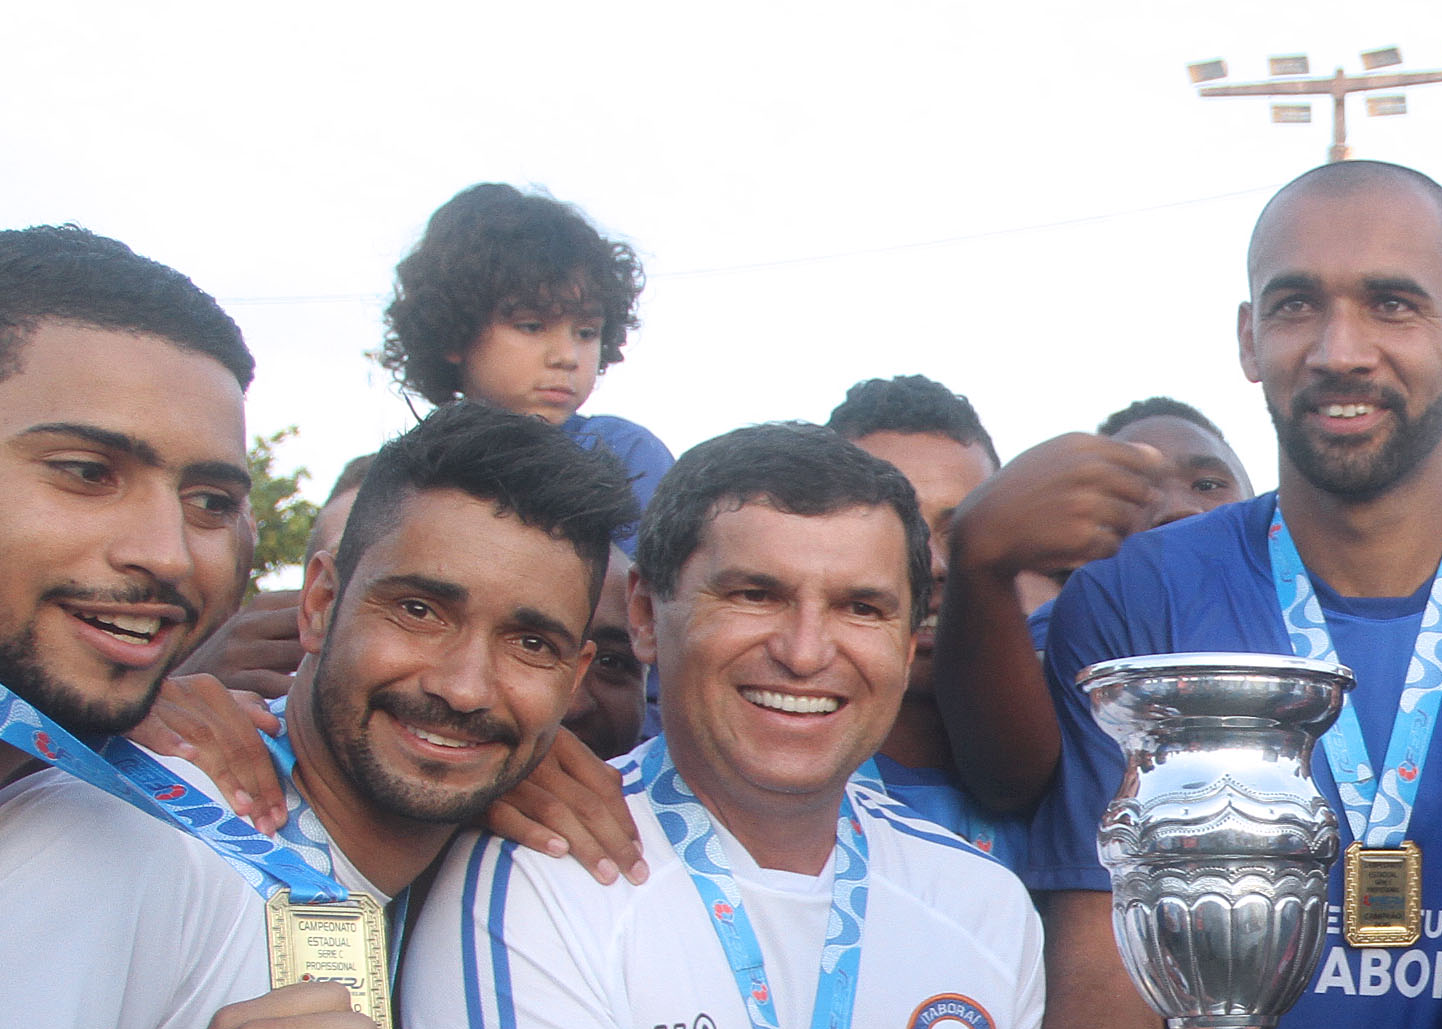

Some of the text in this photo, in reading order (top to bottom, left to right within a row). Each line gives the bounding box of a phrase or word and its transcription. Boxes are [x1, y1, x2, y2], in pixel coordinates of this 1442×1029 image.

[298, 920, 357, 932] CAMPEONATO
[307, 936, 351, 948] ESTADUAL
[305, 961, 357, 971] PROFISSIONAL
